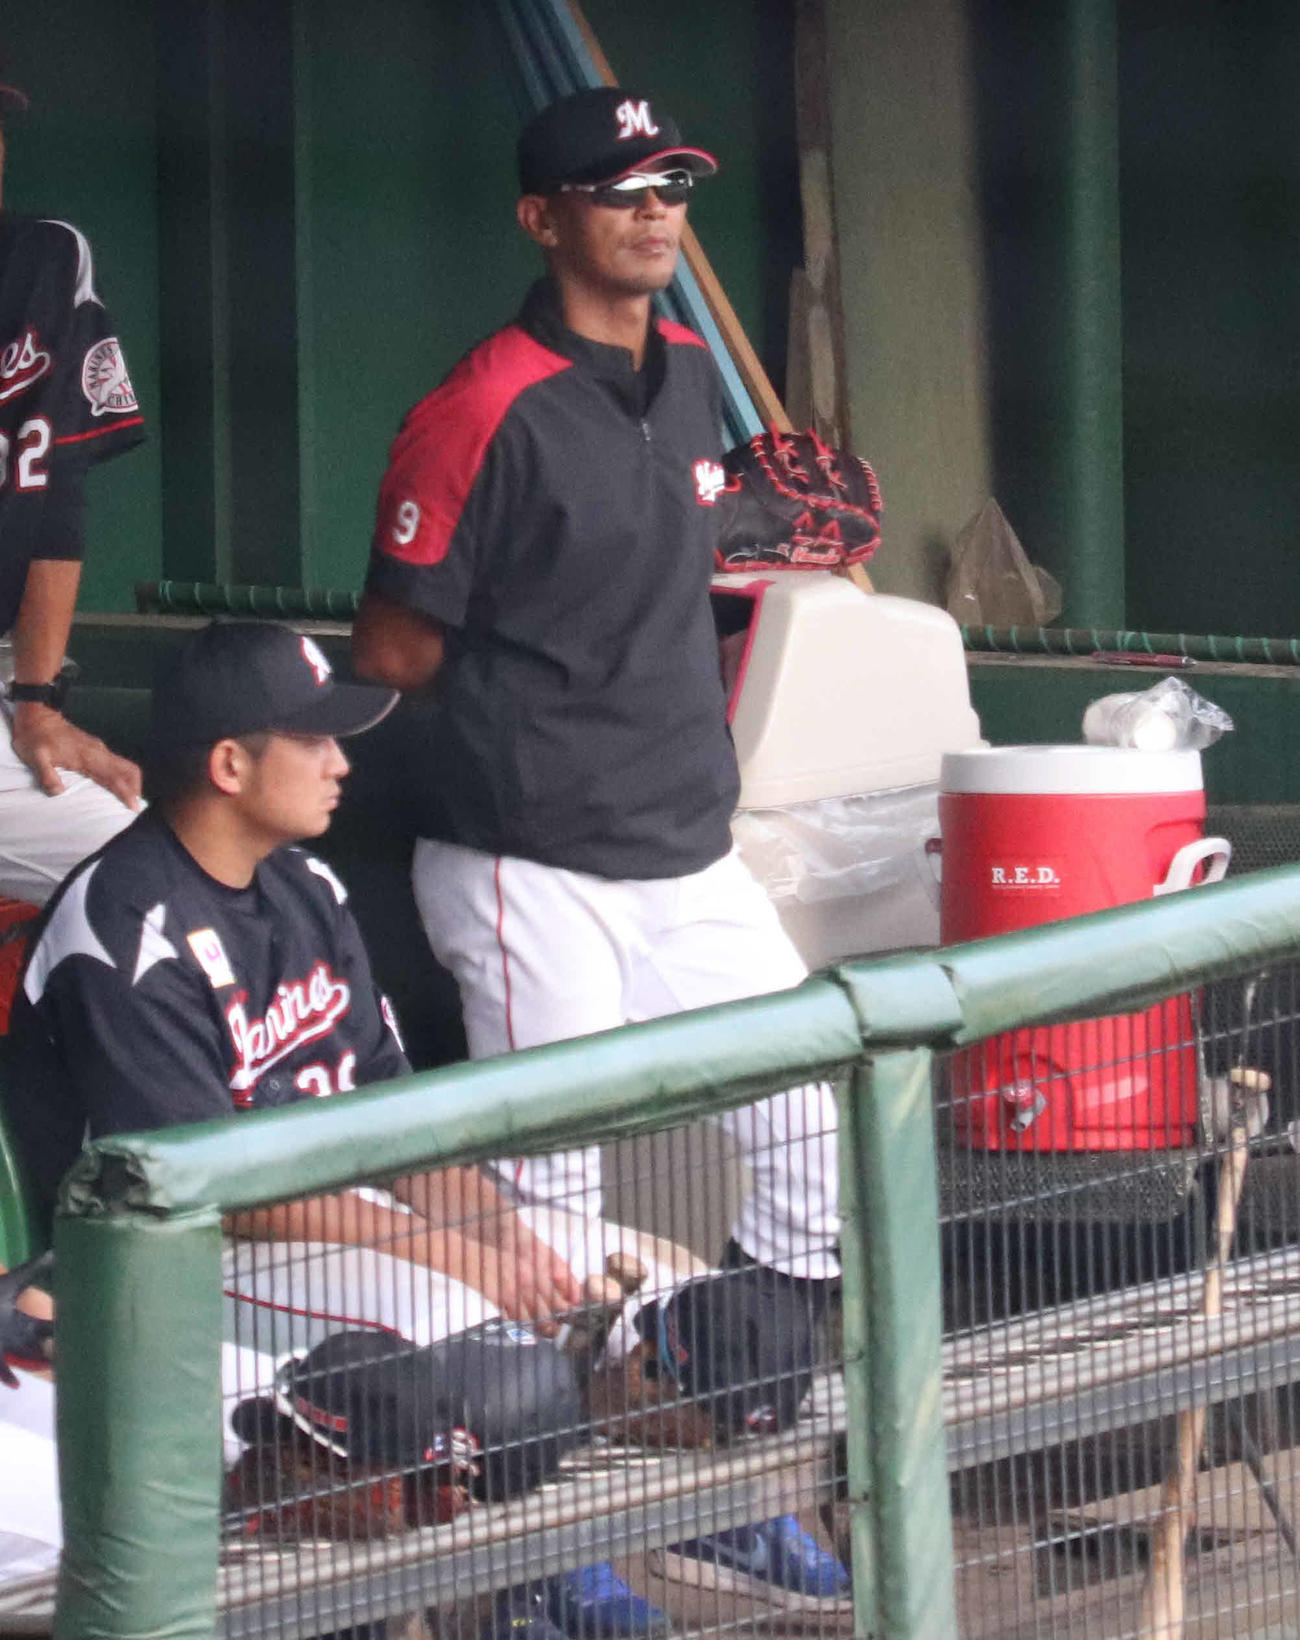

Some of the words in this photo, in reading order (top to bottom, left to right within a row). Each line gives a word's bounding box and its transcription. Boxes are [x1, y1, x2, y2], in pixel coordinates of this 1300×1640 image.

[615, 98, 660, 140] M
[0, 418, 50, 488] 2
[392, 500, 421, 545] 9
[991, 866, 1061, 884] R.E.D.
